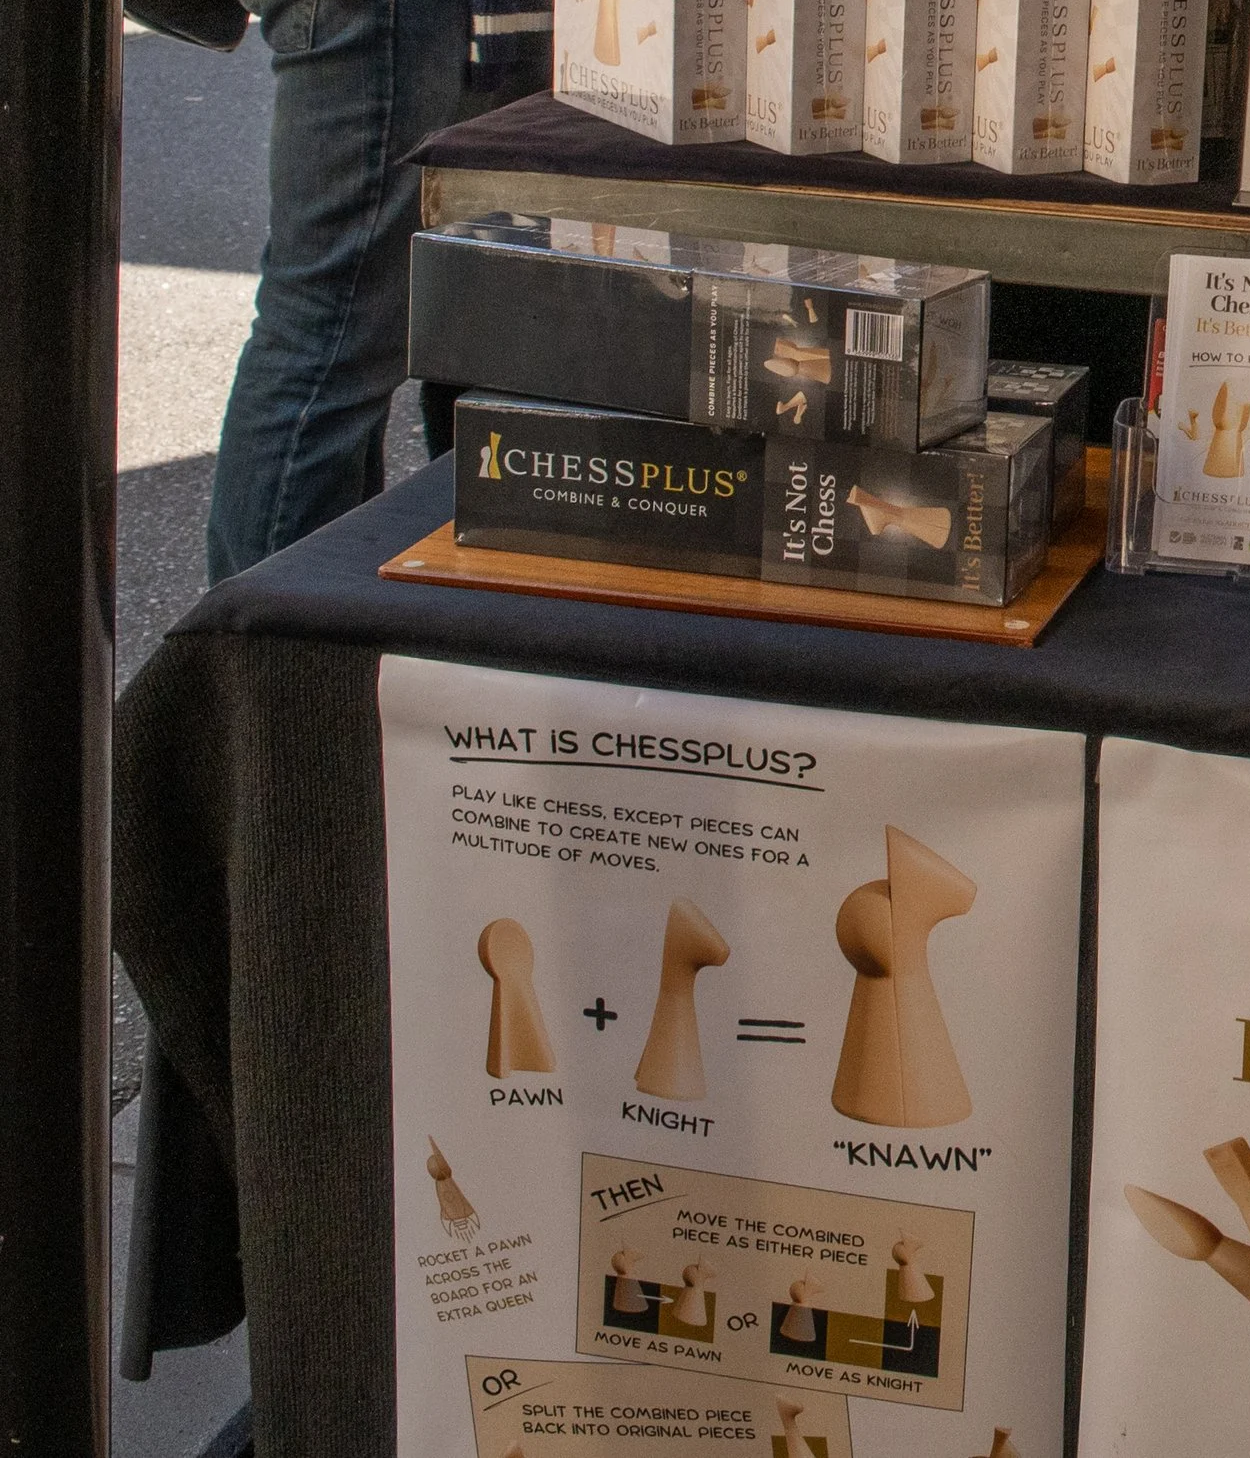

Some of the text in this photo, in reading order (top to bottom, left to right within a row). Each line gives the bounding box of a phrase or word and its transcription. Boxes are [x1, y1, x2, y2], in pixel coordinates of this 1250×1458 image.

[1206, 272, 1234, 291] It's
[710, 330, 716, 344] AS
[1192, 352, 1221, 363] HOW
[1226, 352, 1242, 363] TO
[533, 488, 708, 518] COMBINE & CONQUER
[783, 461, 808, 561] It's Not
[811, 474, 836, 555] Chess
[962, 472, 985, 592] It's Better!
[444, 726, 536, 752] WHAT
[592, 733, 817, 778] CHESSPLUS?
[452, 785, 799, 842] PLAY LIKE CHESS, EXCEPT PIECES CAN
[452, 809, 809, 867] COMBINE TO CREATE NEW ONES FOR A
[452, 832, 661, 873] MULTITUDE OF MOVES.
[489, 1087, 565, 1107] PAWN
[591, 1173, 664, 1210] THEN
[677, 1210, 864, 1248] MOVE THE COMBINED
[418, 1234, 533, 1268] ROCKET A PAWN
[673, 1227, 868, 1266] PIECE AS EITHER PIECE
[425, 1259, 512, 1286] ACROSS THE
[431, 1271, 538, 1305] BOARD FOR AN
[437, 1292, 534, 1322] EXTRA QUEEN
[727, 1312, 759, 1331] OR
[595, 1331, 722, 1362] MOVE AS PAWN
[482, 1369, 521, 1396] OR
[786, 1362, 923, 1393] MOVE AS KNIGHT
[522, 1404, 752, 1422] SPLIT THE COMBINED PIECE
[523, 1422, 756, 1440] BACK INTO ORIGINAL PIECES
